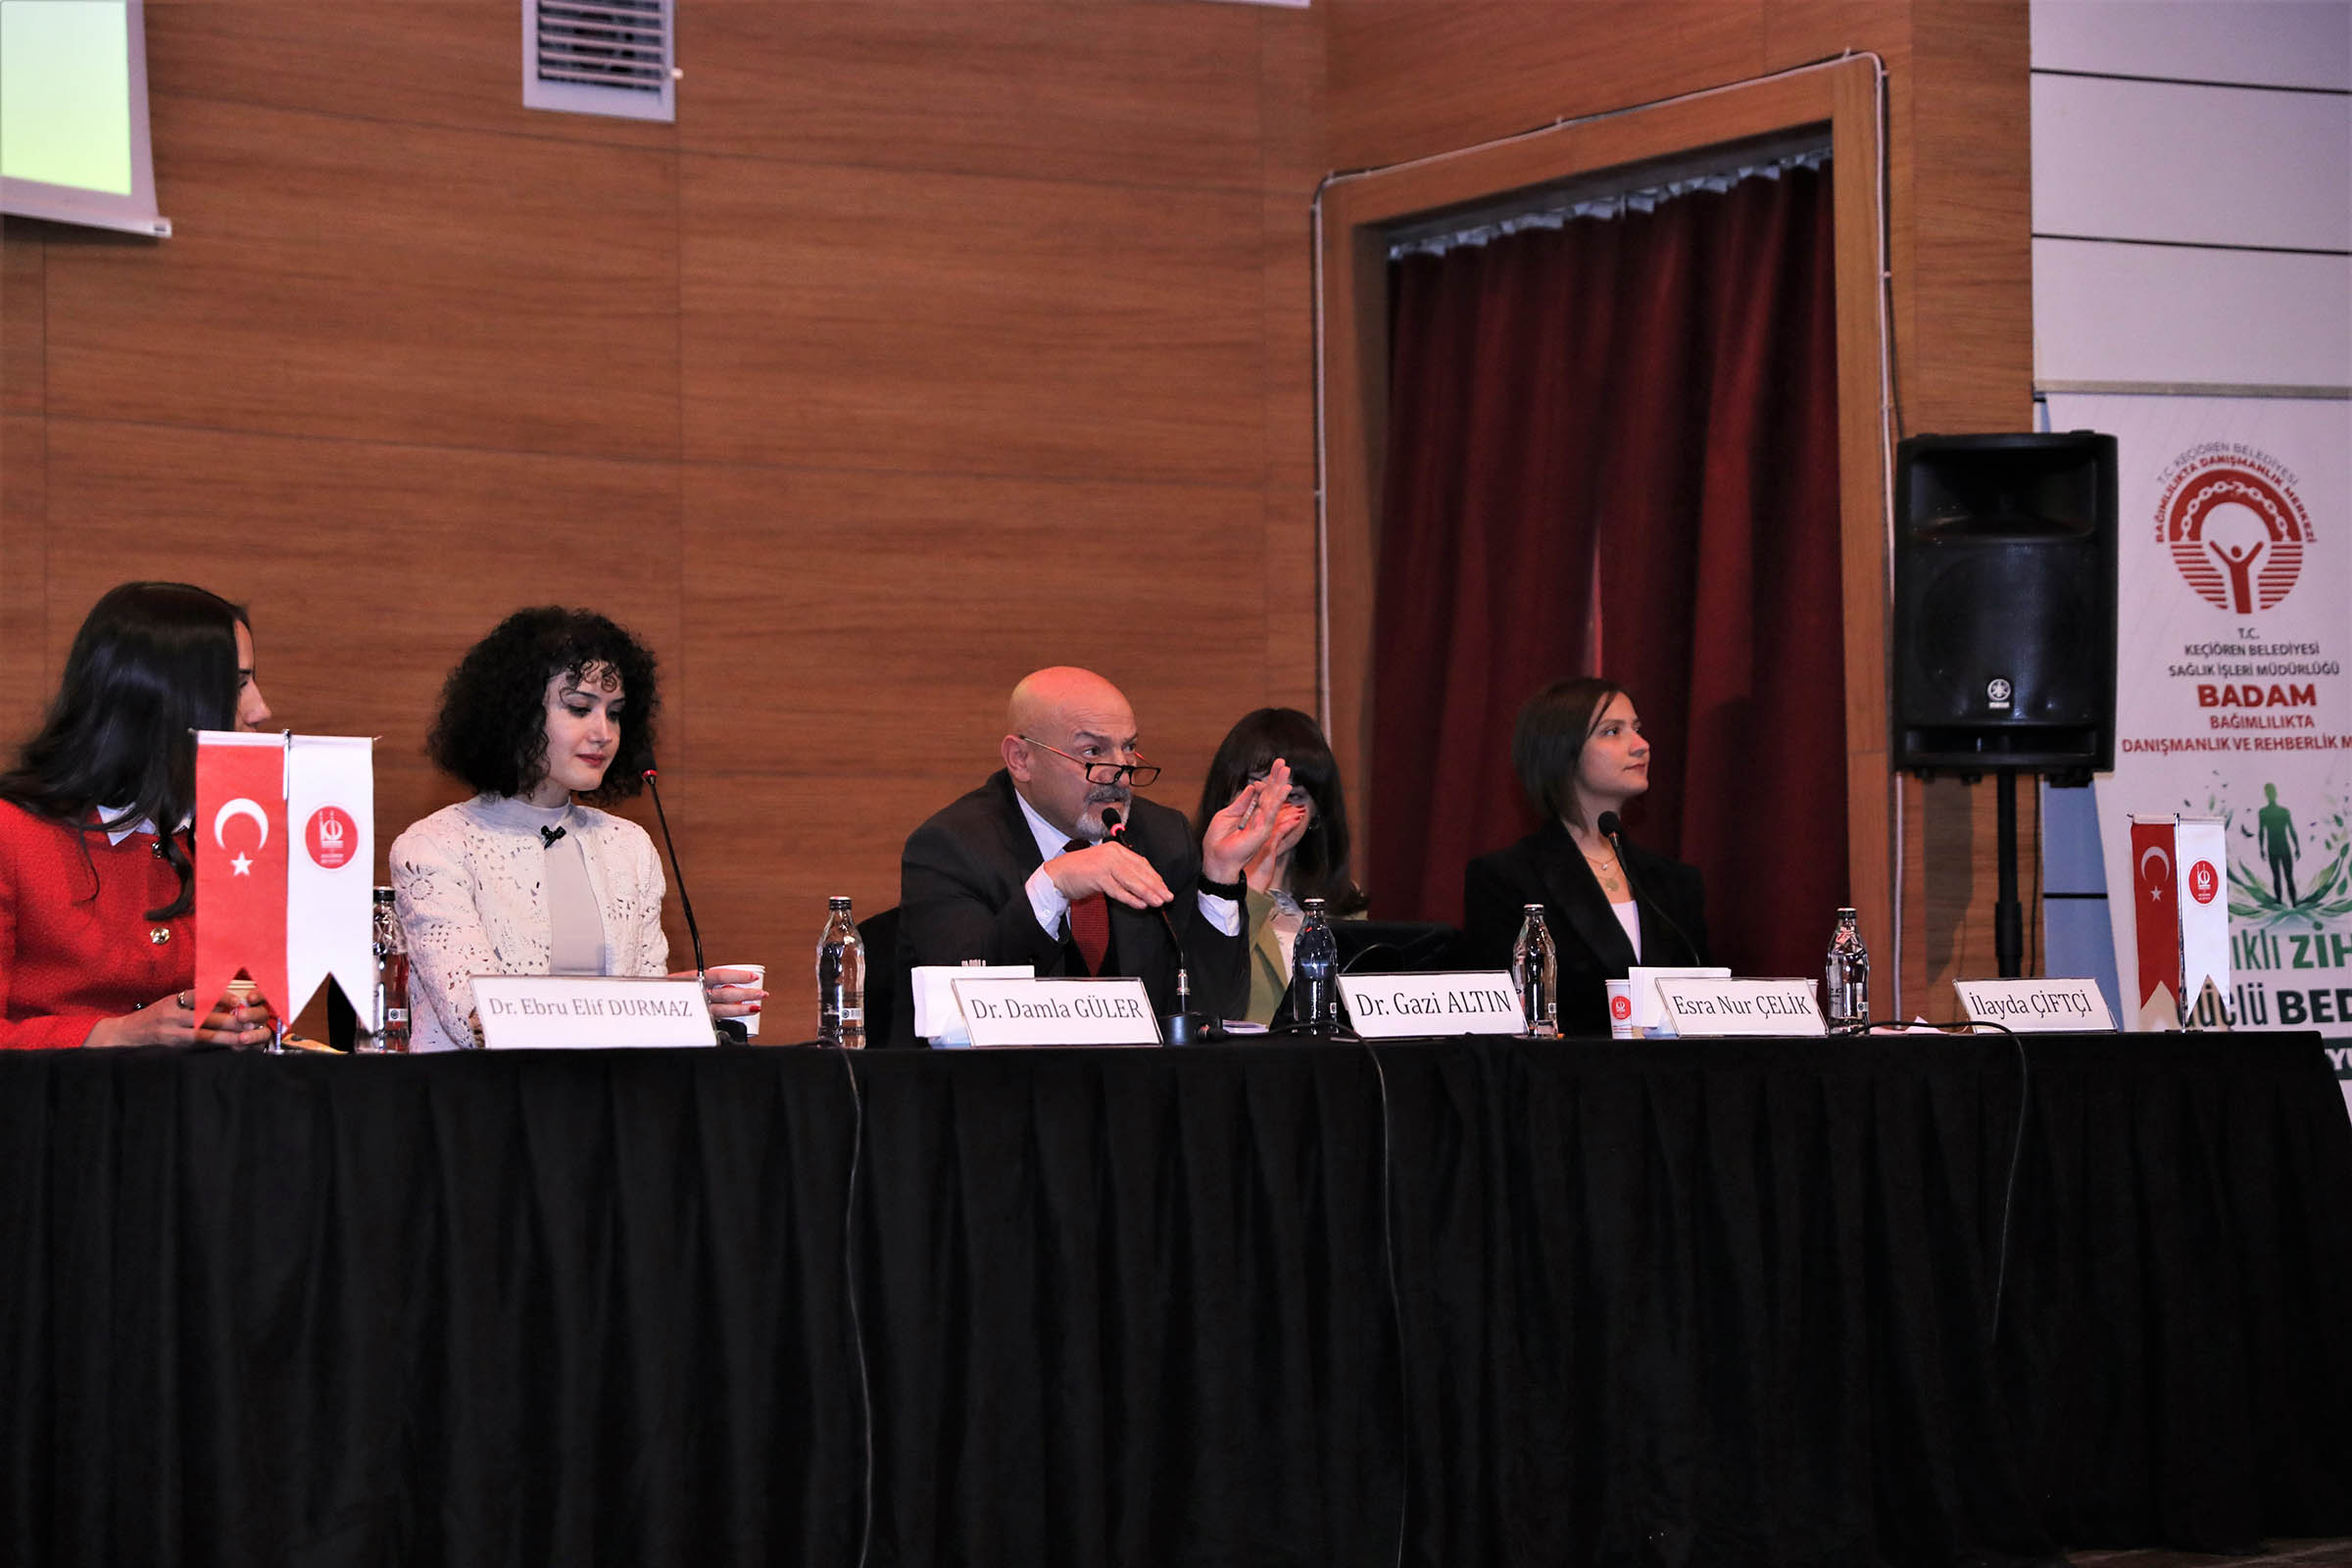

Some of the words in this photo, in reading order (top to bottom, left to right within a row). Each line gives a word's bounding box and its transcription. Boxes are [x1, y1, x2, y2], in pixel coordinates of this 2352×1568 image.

[2237, 627, 2260, 639] T.C.
[2184, 641, 2245, 659] KEÇİÖREN
[2249, 640, 2320, 656] BELEDİYESİ
[2169, 662, 2215, 677] SAĞLIK
[2218, 662, 2253, 678] İŞLERİ
[2256, 661, 2339, 676] MÜDÜRLÜĞÜ
[2196, 683, 2317, 708] BADAM
[2210, 712, 2315, 729] BAĞIMLILIKTA
[2122, 737, 2230, 757] DANIŞMANLIK
[2233, 737, 2251, 751] VE
[2255, 733, 2337, 751] REHBERLİK
[2231, 929, 2281, 970] ıklı
[489, 998, 517, 1014] Dr.
[520, 998, 567, 1015] Ebru
[572, 998, 605, 1015] Elif
[608, 1000, 693, 1017] DURMAZ
[970, 999, 1003, 1018] Dr.
[1004, 998, 1071, 1019] Damla
[1074, 995, 1144, 1019] GÜLER
[1355, 994, 1390, 1016] Dr.
[1394, 992, 1442, 1015] Gazi
[1447, 990, 1512, 1013] ALTIN
[1672, 996, 1716, 1014] Esra
[1717, 996, 1751, 1014] Nur
[1755, 992, 1812, 1018] ÇELİK
[1969, 992, 2031, 1019] İlayda
[2031, 989, 2093, 1018] ÇİFTÇİ
